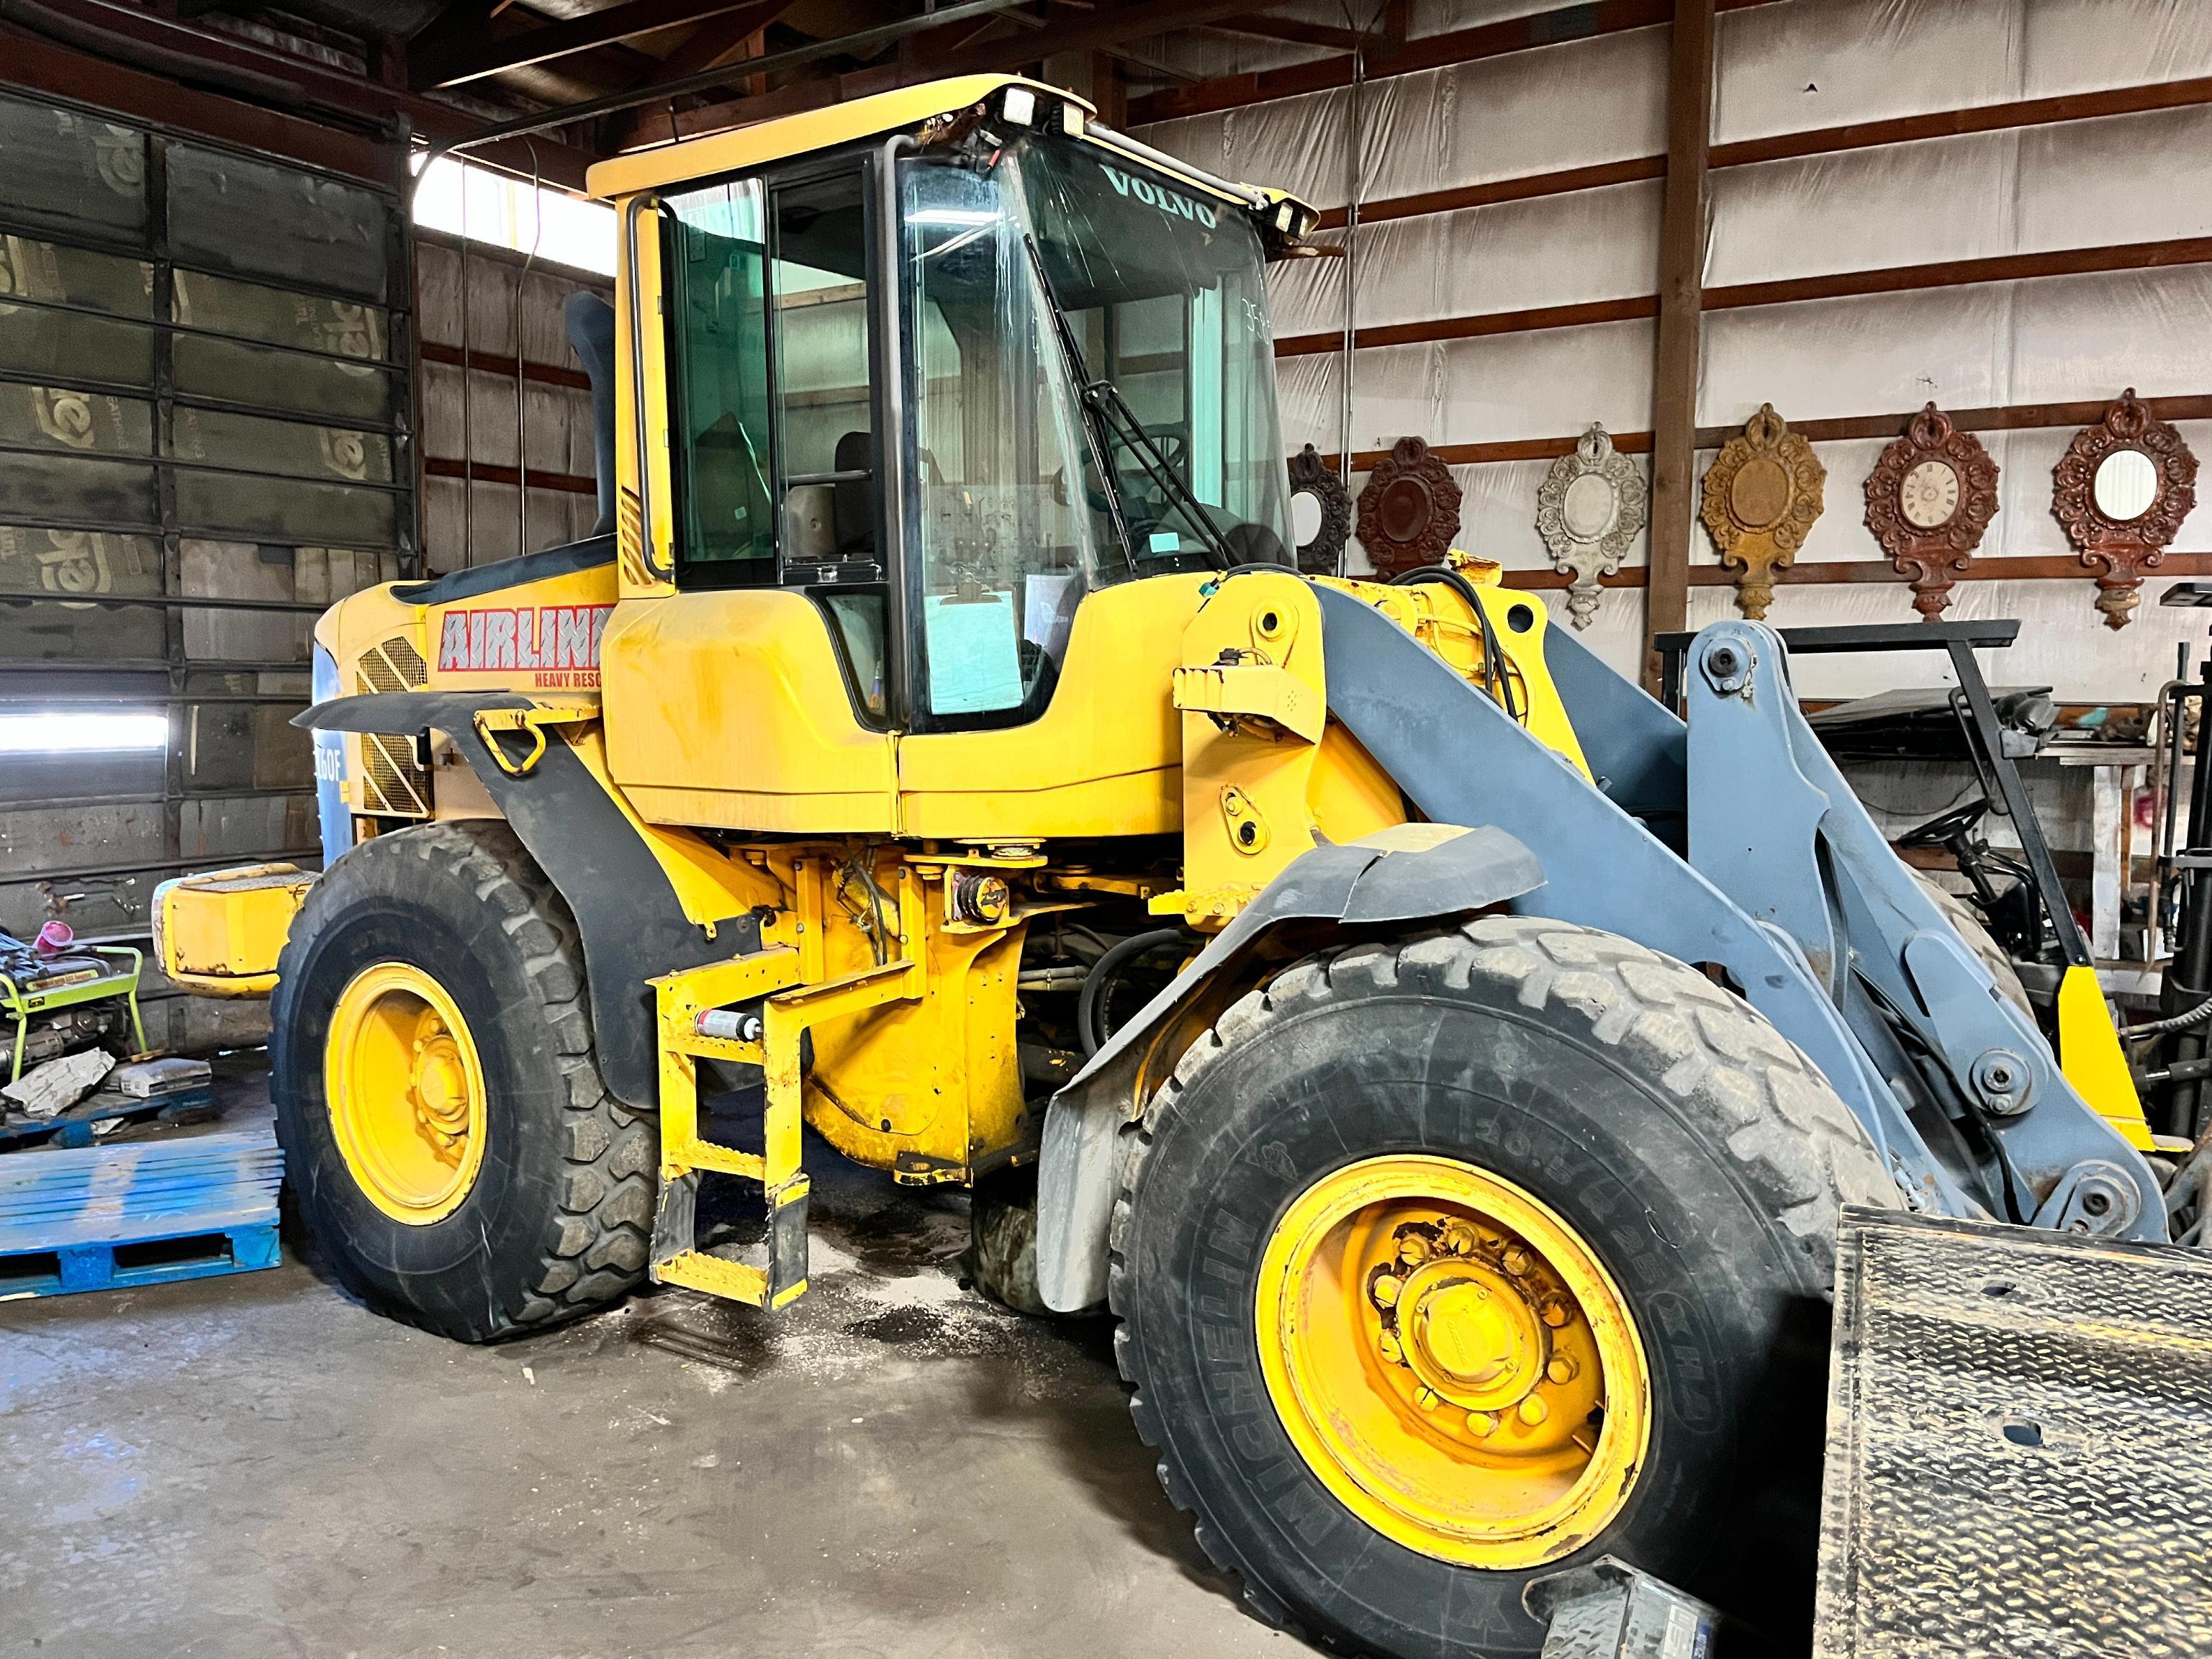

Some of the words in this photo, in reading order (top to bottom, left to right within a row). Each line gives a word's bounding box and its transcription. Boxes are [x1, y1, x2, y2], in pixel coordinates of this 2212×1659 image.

[1098, 163, 1216, 229] VOLVO
[535, 673, 570, 688] HEAVY
[1197, 1208, 1342, 1547] MICHELIN
